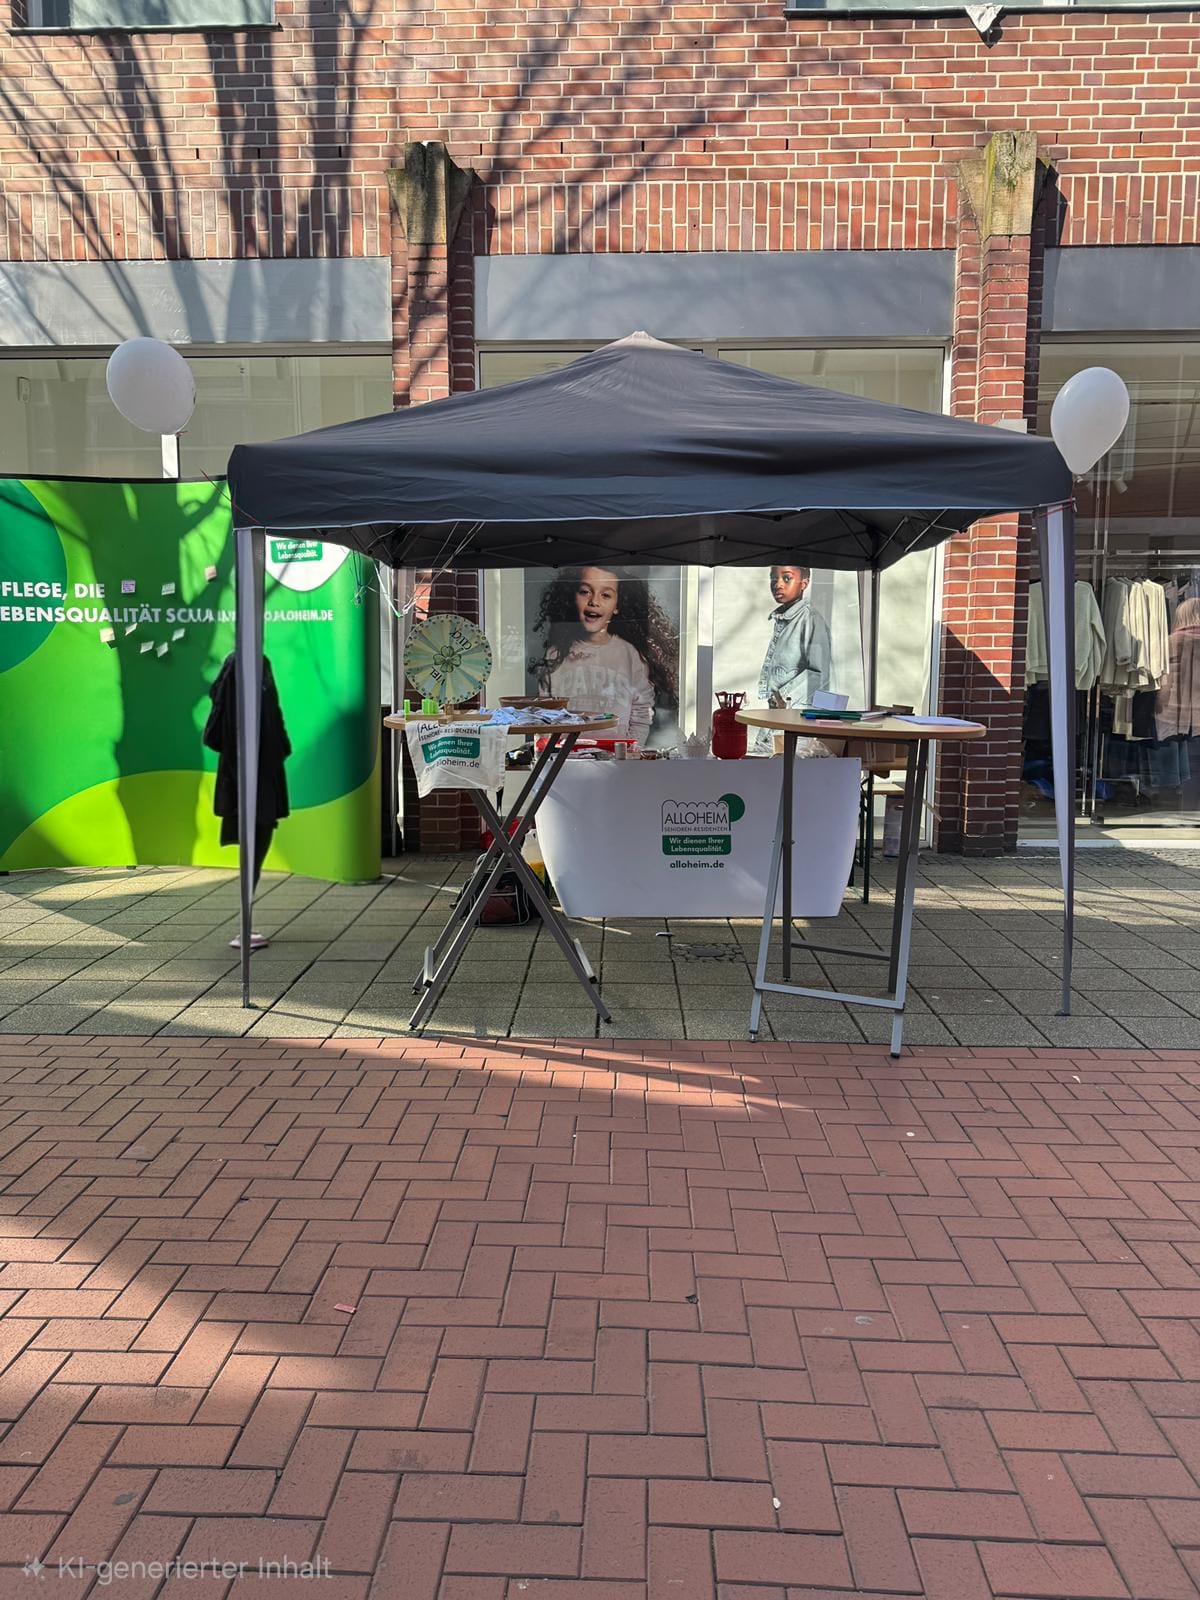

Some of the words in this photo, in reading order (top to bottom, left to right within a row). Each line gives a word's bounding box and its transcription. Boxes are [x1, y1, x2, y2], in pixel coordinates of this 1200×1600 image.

[0, 581, 68, 600] FLEGE,
[74, 583, 105, 598] DIE
[0, 603, 161, 623] EBENSQUALITÄT
[457, 739, 473, 747] Ihrer
[664, 811, 728, 825] ALLOHEIM
[669, 837, 682, 845] Wir
[682, 837, 707, 845] dienen
[708, 837, 724, 845] Ihrer
[669, 860, 725, 869] alloheim.de
